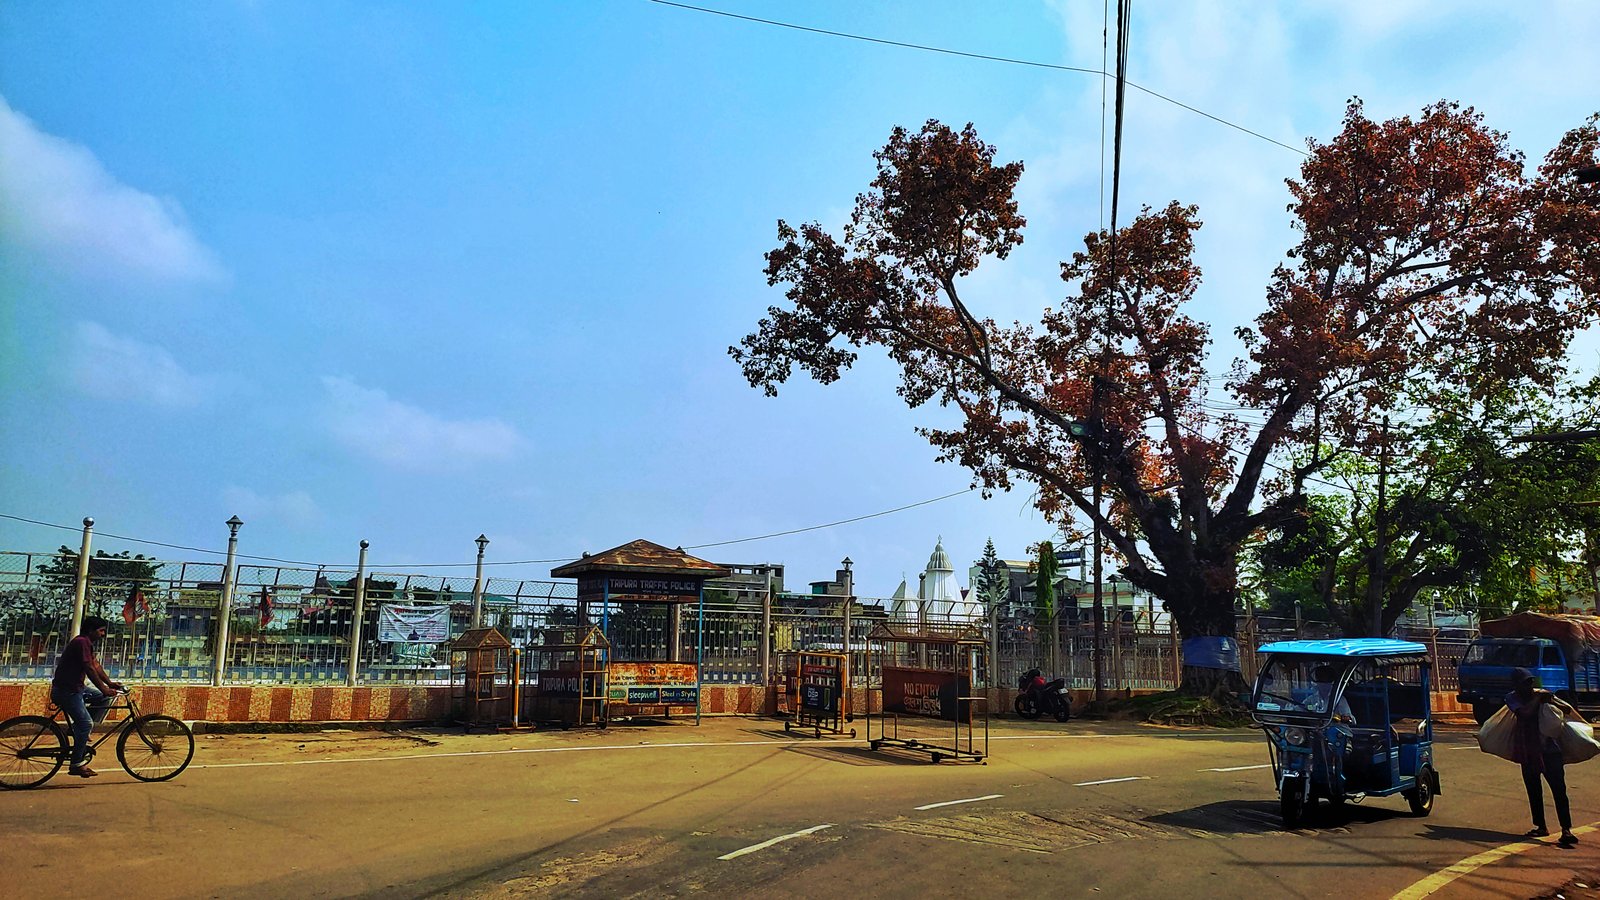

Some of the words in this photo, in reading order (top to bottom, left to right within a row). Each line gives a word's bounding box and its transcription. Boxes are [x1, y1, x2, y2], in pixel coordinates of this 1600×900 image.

[609, 578, 638, 588] TRIPURA
[640, 579, 668, 590] TRAFFIC
[670, 580, 695, 591] POLICE
[567, 677, 589, 693] POLIE
[904, 682, 914, 695] NO
[915, 683, 940, 697] ENTRY
[629, 690, 657, 702] sleepwell
